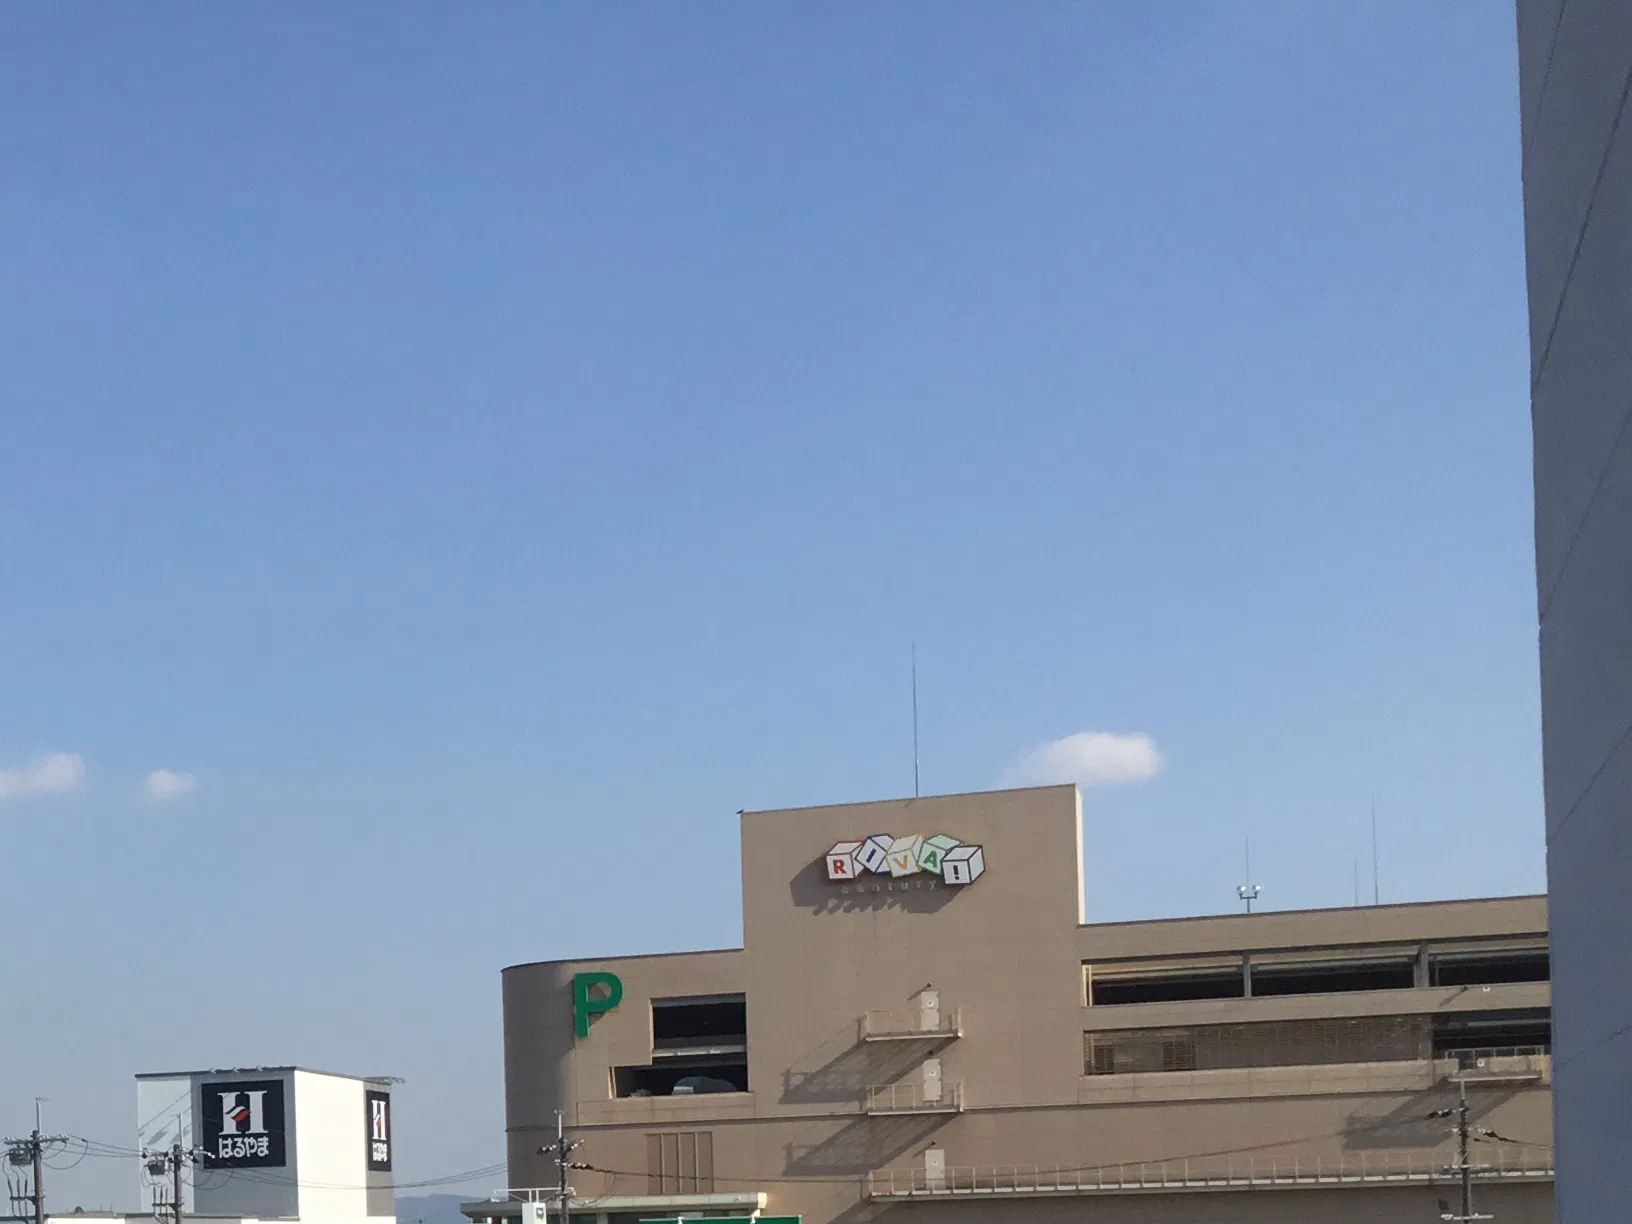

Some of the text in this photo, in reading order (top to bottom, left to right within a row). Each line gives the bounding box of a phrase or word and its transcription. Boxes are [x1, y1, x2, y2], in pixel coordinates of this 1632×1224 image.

[573, 971, 623, 1038] P
[218, 1136, 269, 1159] はるやま
